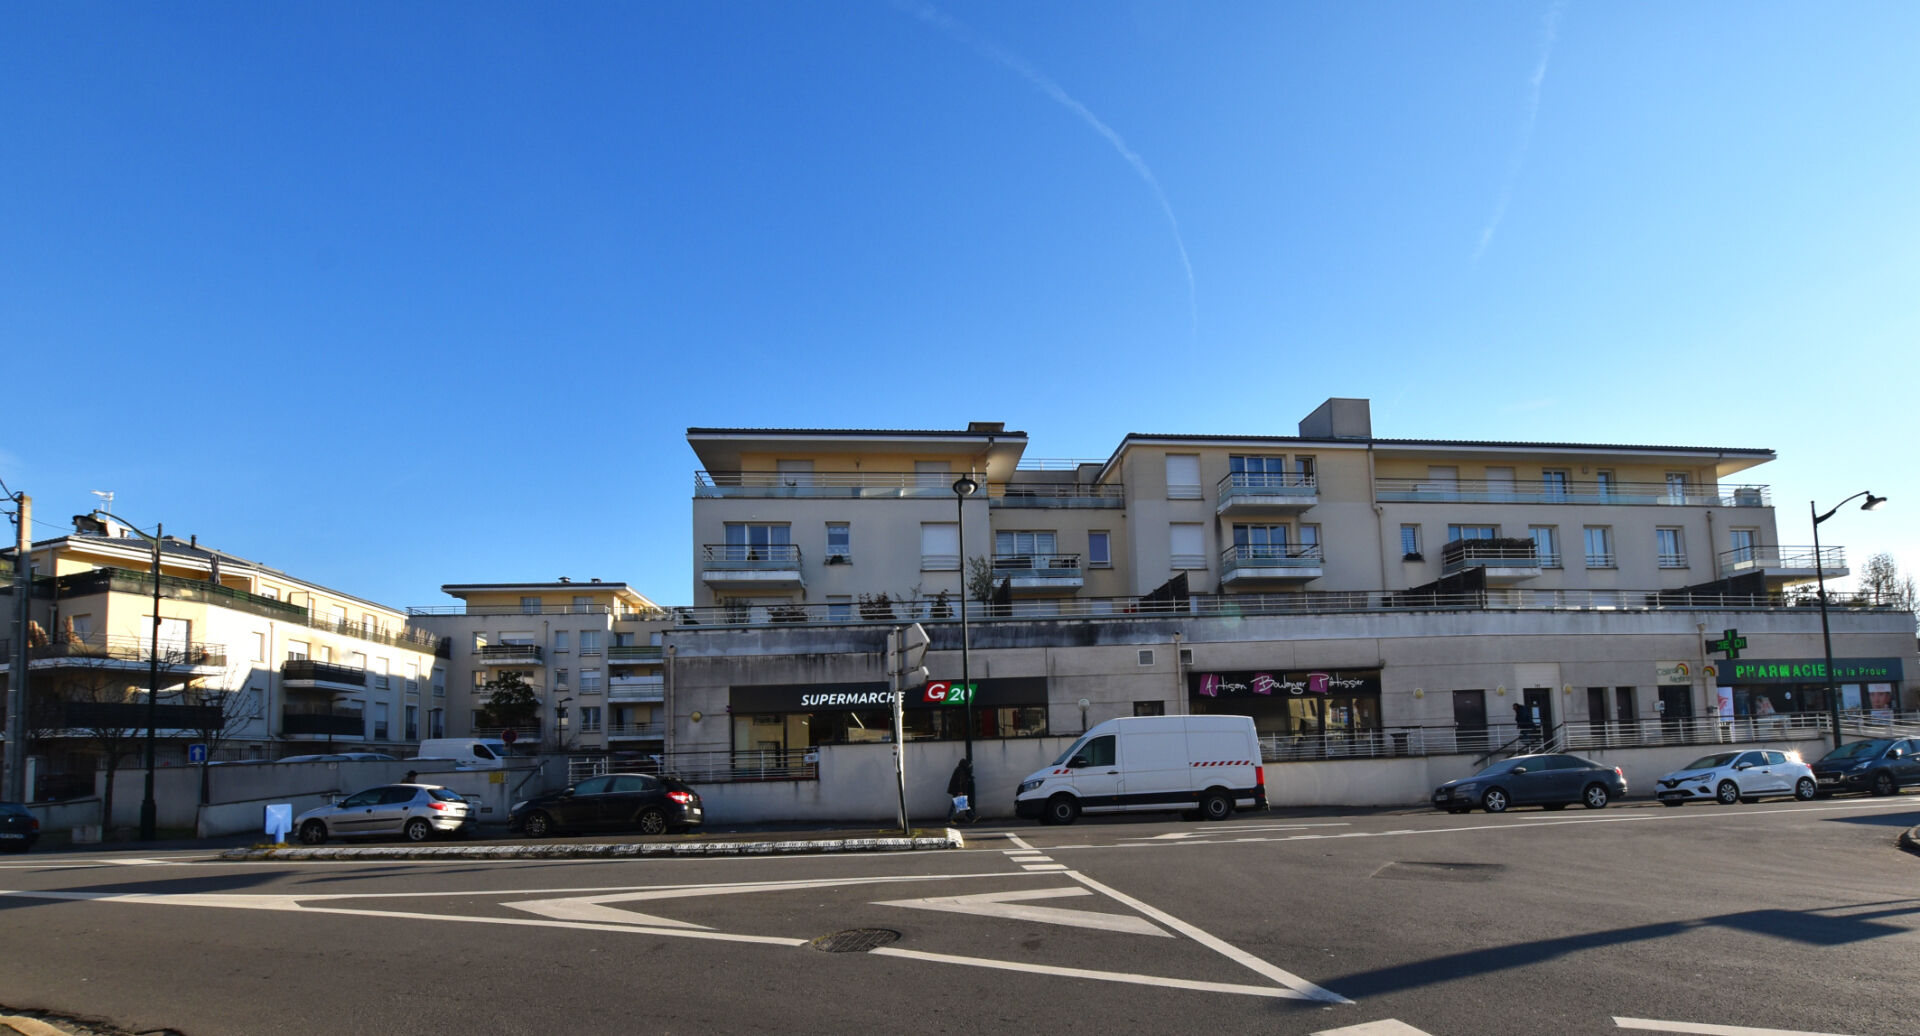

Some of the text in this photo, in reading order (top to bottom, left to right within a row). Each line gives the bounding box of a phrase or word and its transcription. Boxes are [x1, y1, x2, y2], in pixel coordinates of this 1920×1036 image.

[1735, 664, 1827, 678] PHARMACIE
[1858, 667, 1888, 676] Proue
[1204, 673, 1247, 697] Artisan
[1250, 673, 1306, 695] Boulanger
